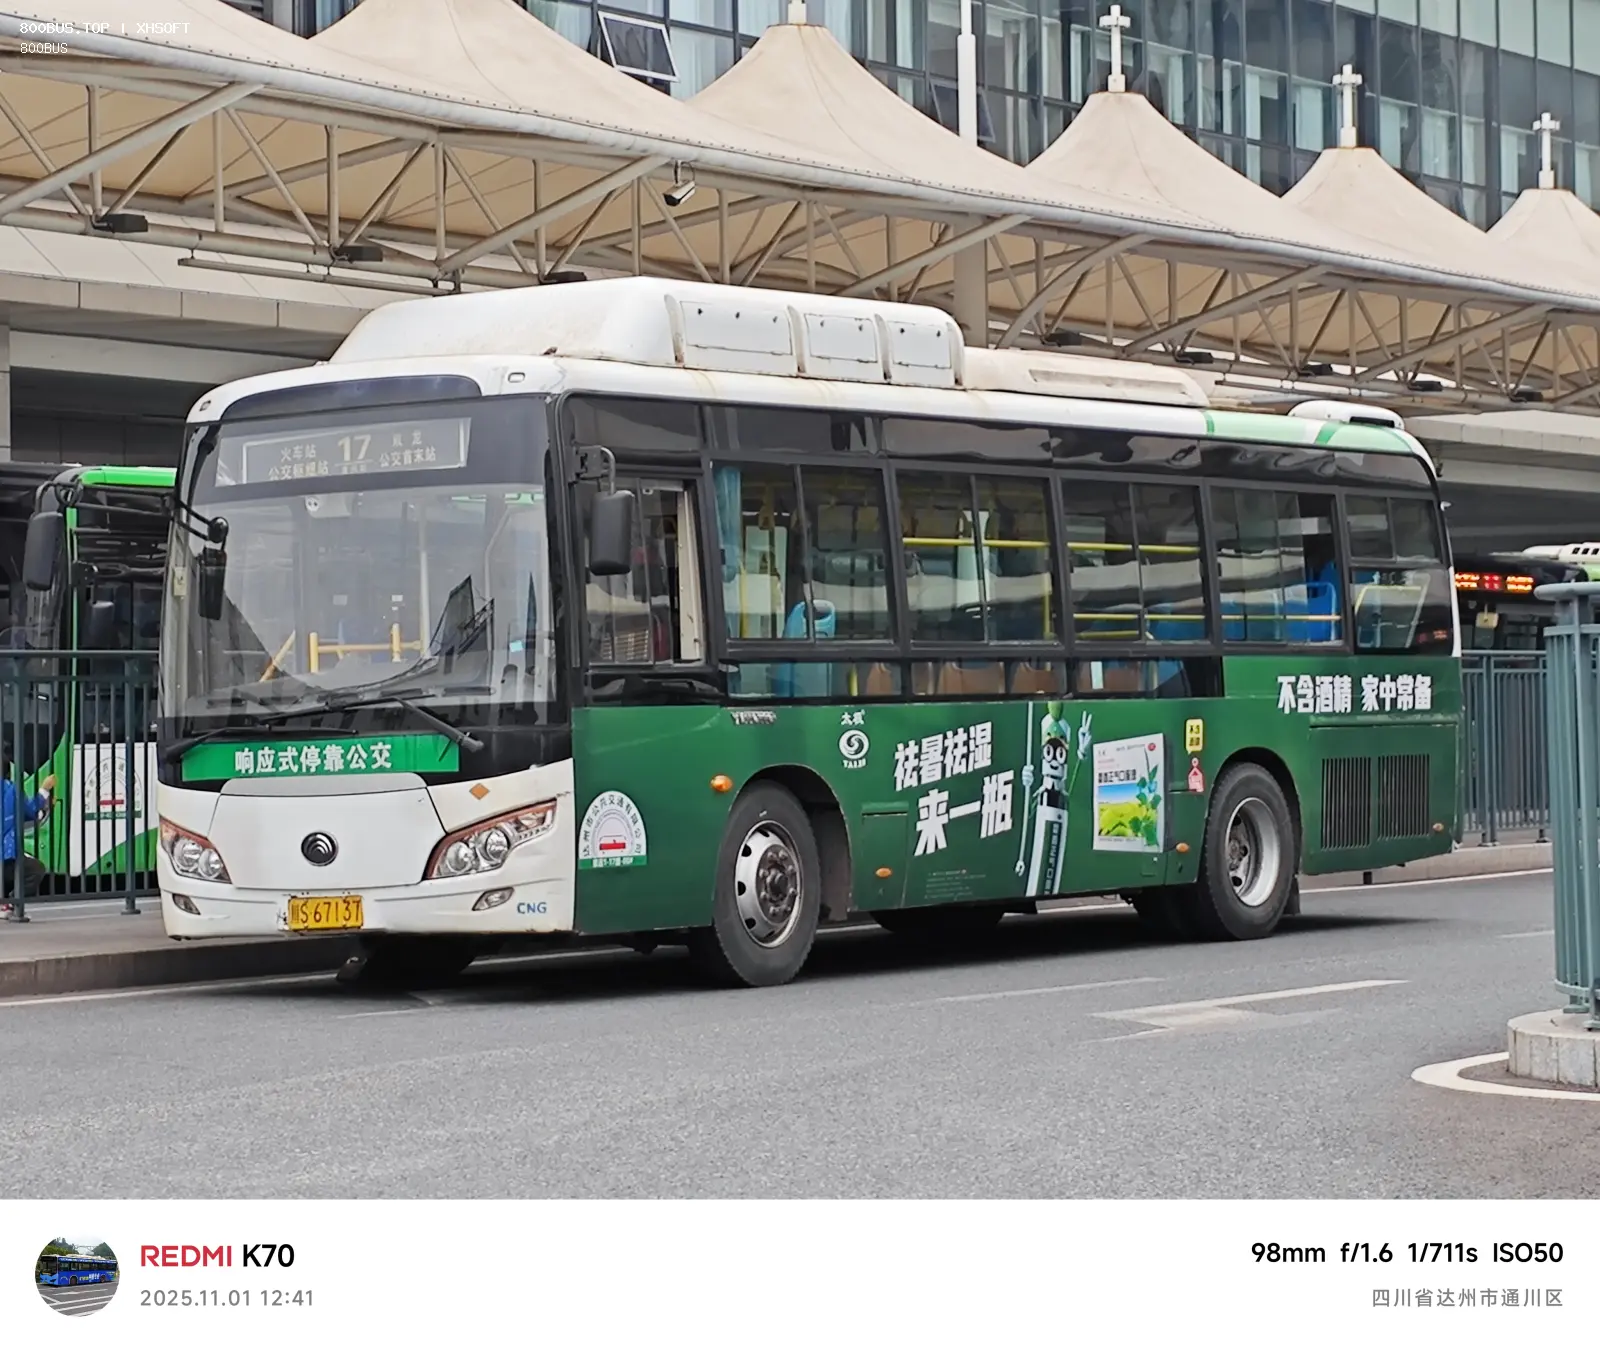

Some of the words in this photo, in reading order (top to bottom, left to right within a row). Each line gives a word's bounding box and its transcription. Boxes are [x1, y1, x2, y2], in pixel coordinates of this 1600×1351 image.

[281, 444, 316, 463] 火车站
[338, 434, 371, 461] 17
[379, 446, 436, 468] 公交首末站
[1277, 675, 1352, 714] 不含酒精
[1361, 673, 1432, 711] 家中常备
[234, 742, 392, 774] 响应式停靠公交
[894, 721, 992, 791] 祛暑祛湿
[914, 770, 1015, 856] 来一瓶
[516, 902, 547, 914] CNG
